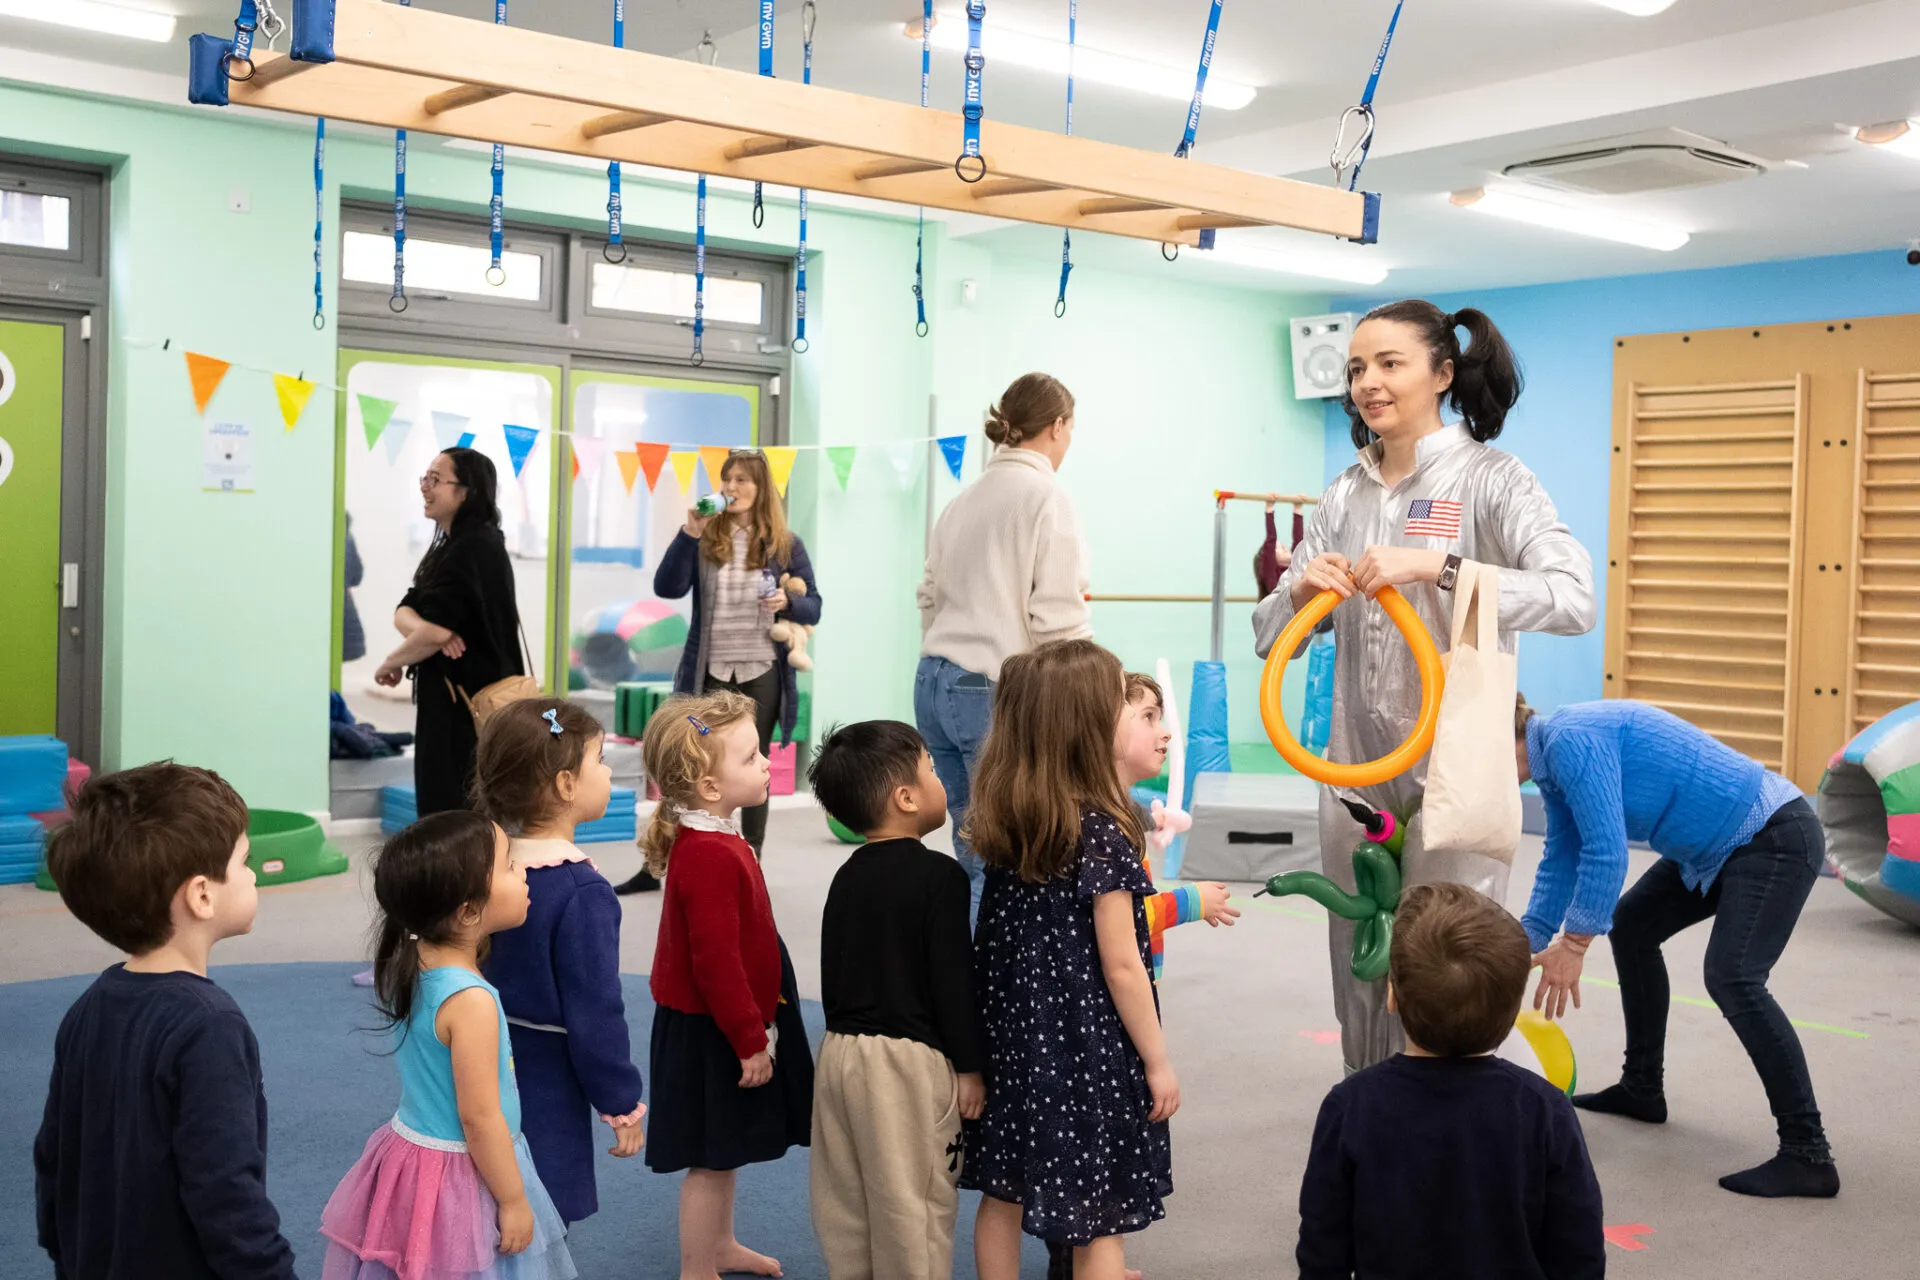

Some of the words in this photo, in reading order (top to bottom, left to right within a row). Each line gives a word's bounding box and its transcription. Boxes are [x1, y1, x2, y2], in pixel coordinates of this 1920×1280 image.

[762, 2, 772, 20] MY
[761, 22, 772, 49] GYM
[1205, 29, 1216, 52] GYM
[1201, 51, 1212, 67] MY
[968, 80, 980, 102] MY
[1188, 113, 1199, 130] MY
[611, 211, 620, 234] GYM
